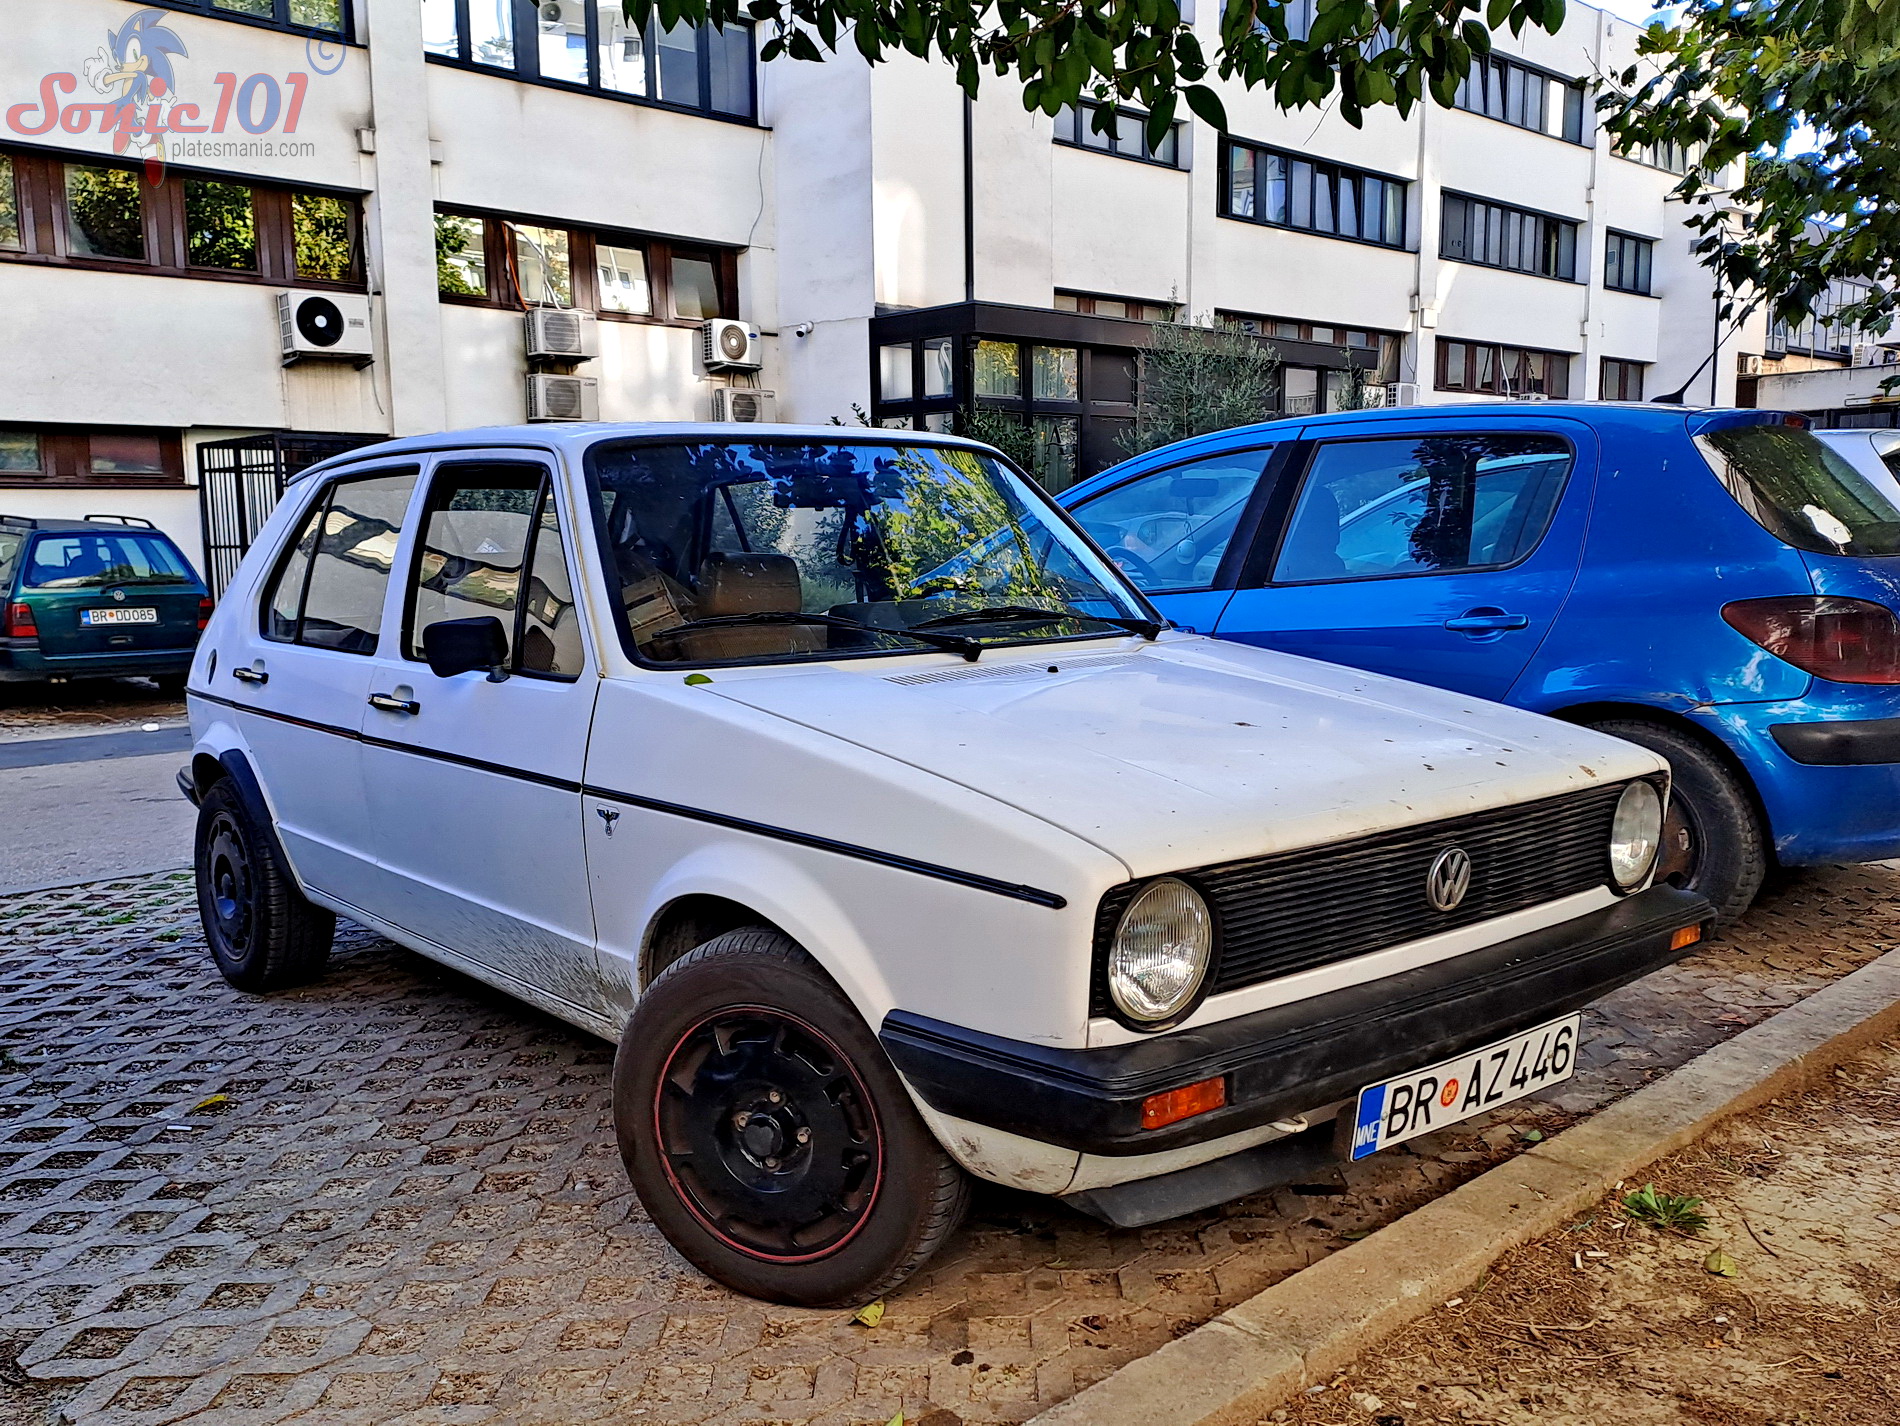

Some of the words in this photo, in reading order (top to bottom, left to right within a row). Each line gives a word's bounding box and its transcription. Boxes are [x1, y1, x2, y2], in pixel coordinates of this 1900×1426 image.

[92, 610, 108, 622] BR
[1385, 1077, 1438, 1140] BR
[1461, 1026, 1573, 1113] AZ446
[1356, 1120, 1380, 1149] MNE
